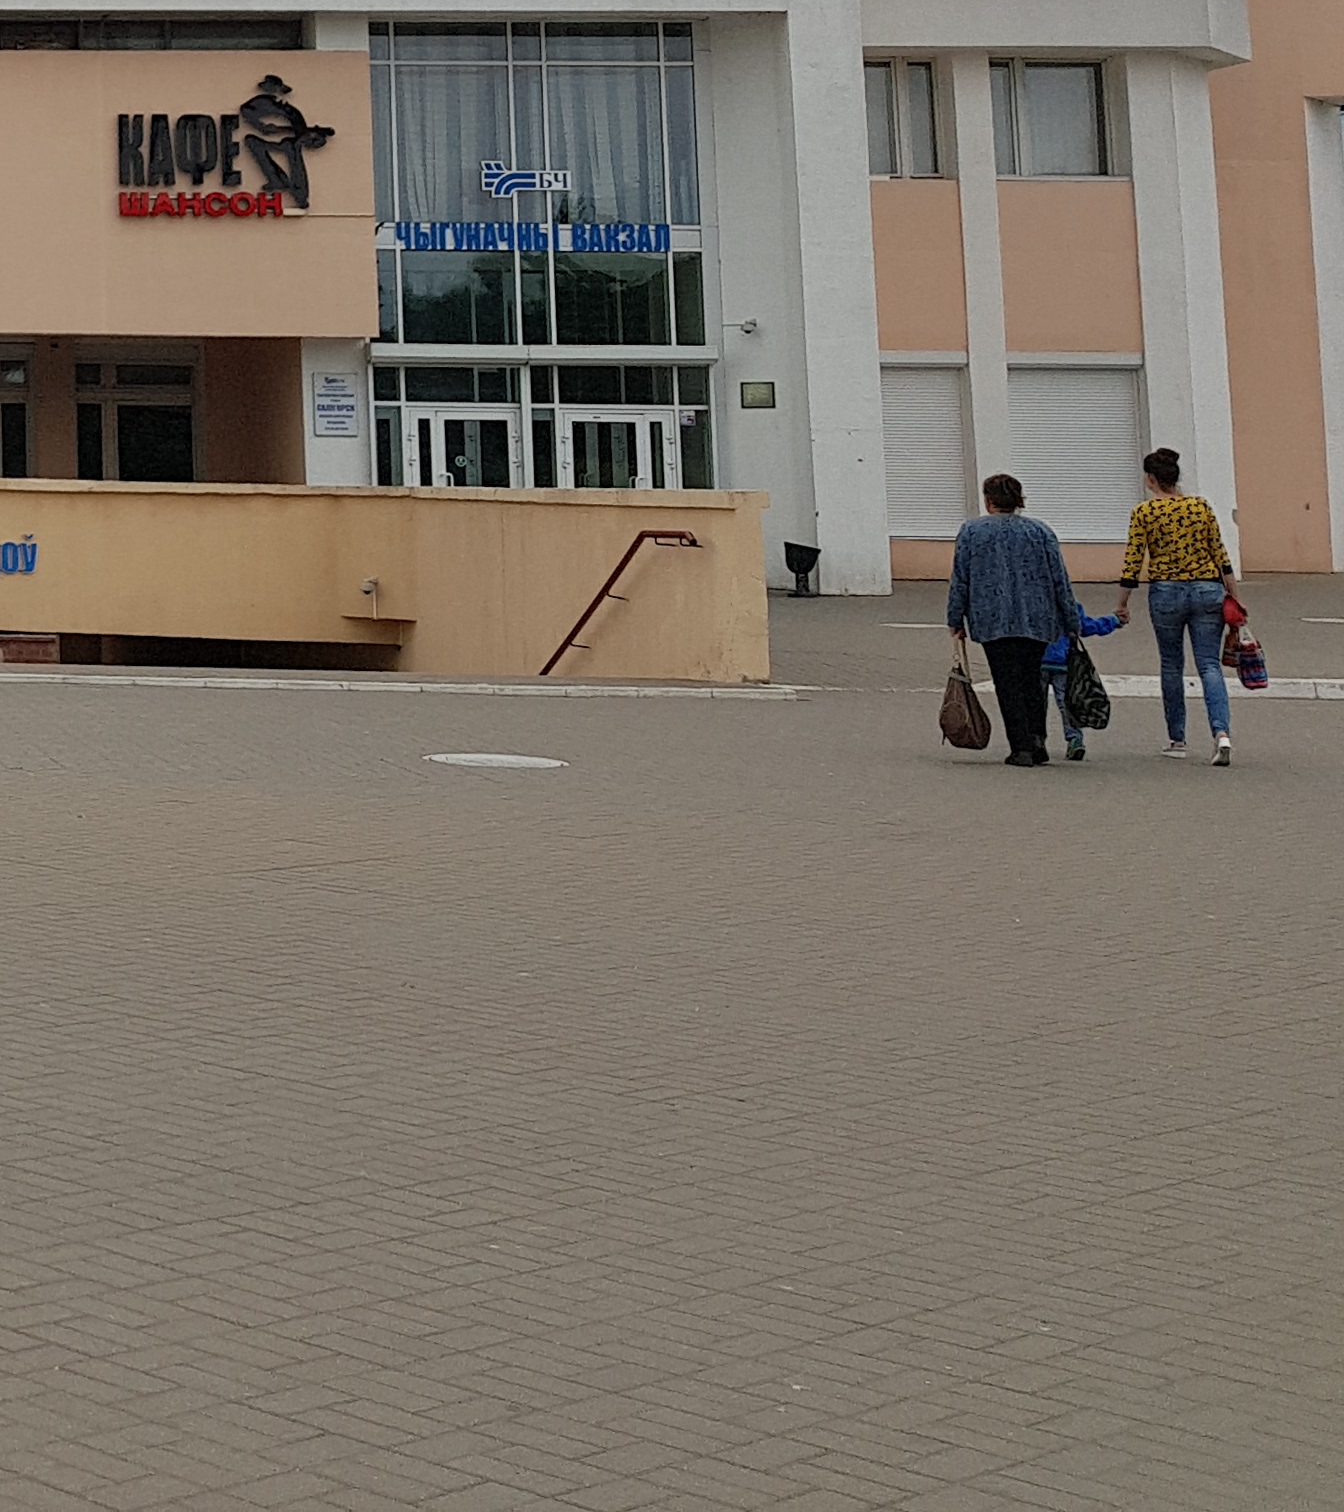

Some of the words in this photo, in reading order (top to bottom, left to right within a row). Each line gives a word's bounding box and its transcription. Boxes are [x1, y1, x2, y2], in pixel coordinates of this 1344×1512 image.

[117, 113, 243, 187] КАФЕ
[538, 171, 569, 189] БЧ
[118, 191, 284, 218] ШАНСОН
[395, 221, 560, 252] ЧЫГУНАЧНЫ
[570, 223, 671, 253] ВАКЗАЛ
